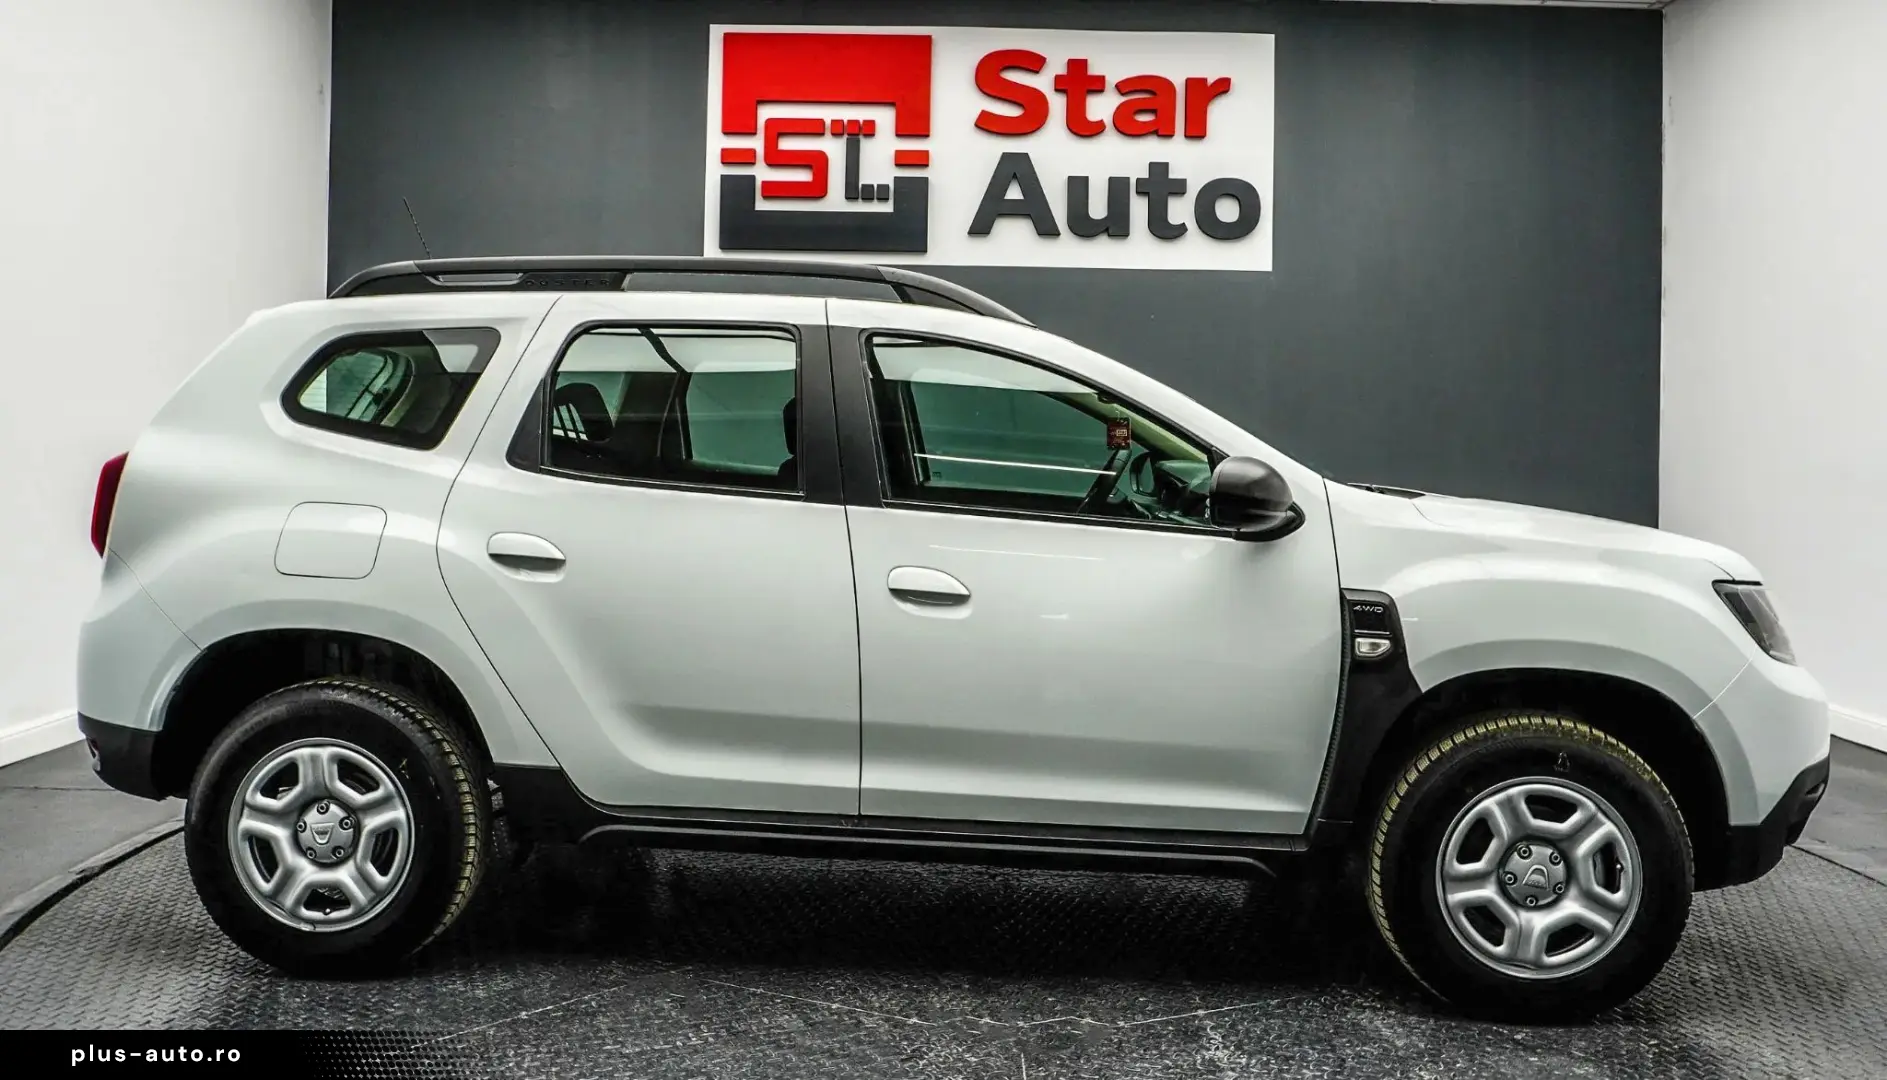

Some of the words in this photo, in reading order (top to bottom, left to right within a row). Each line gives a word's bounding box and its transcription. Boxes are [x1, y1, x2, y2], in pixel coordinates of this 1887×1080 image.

[974, 49, 1231, 138] Star
[967, 151, 1261, 241] Auto
[1353, 605, 1384, 613] 4WD
